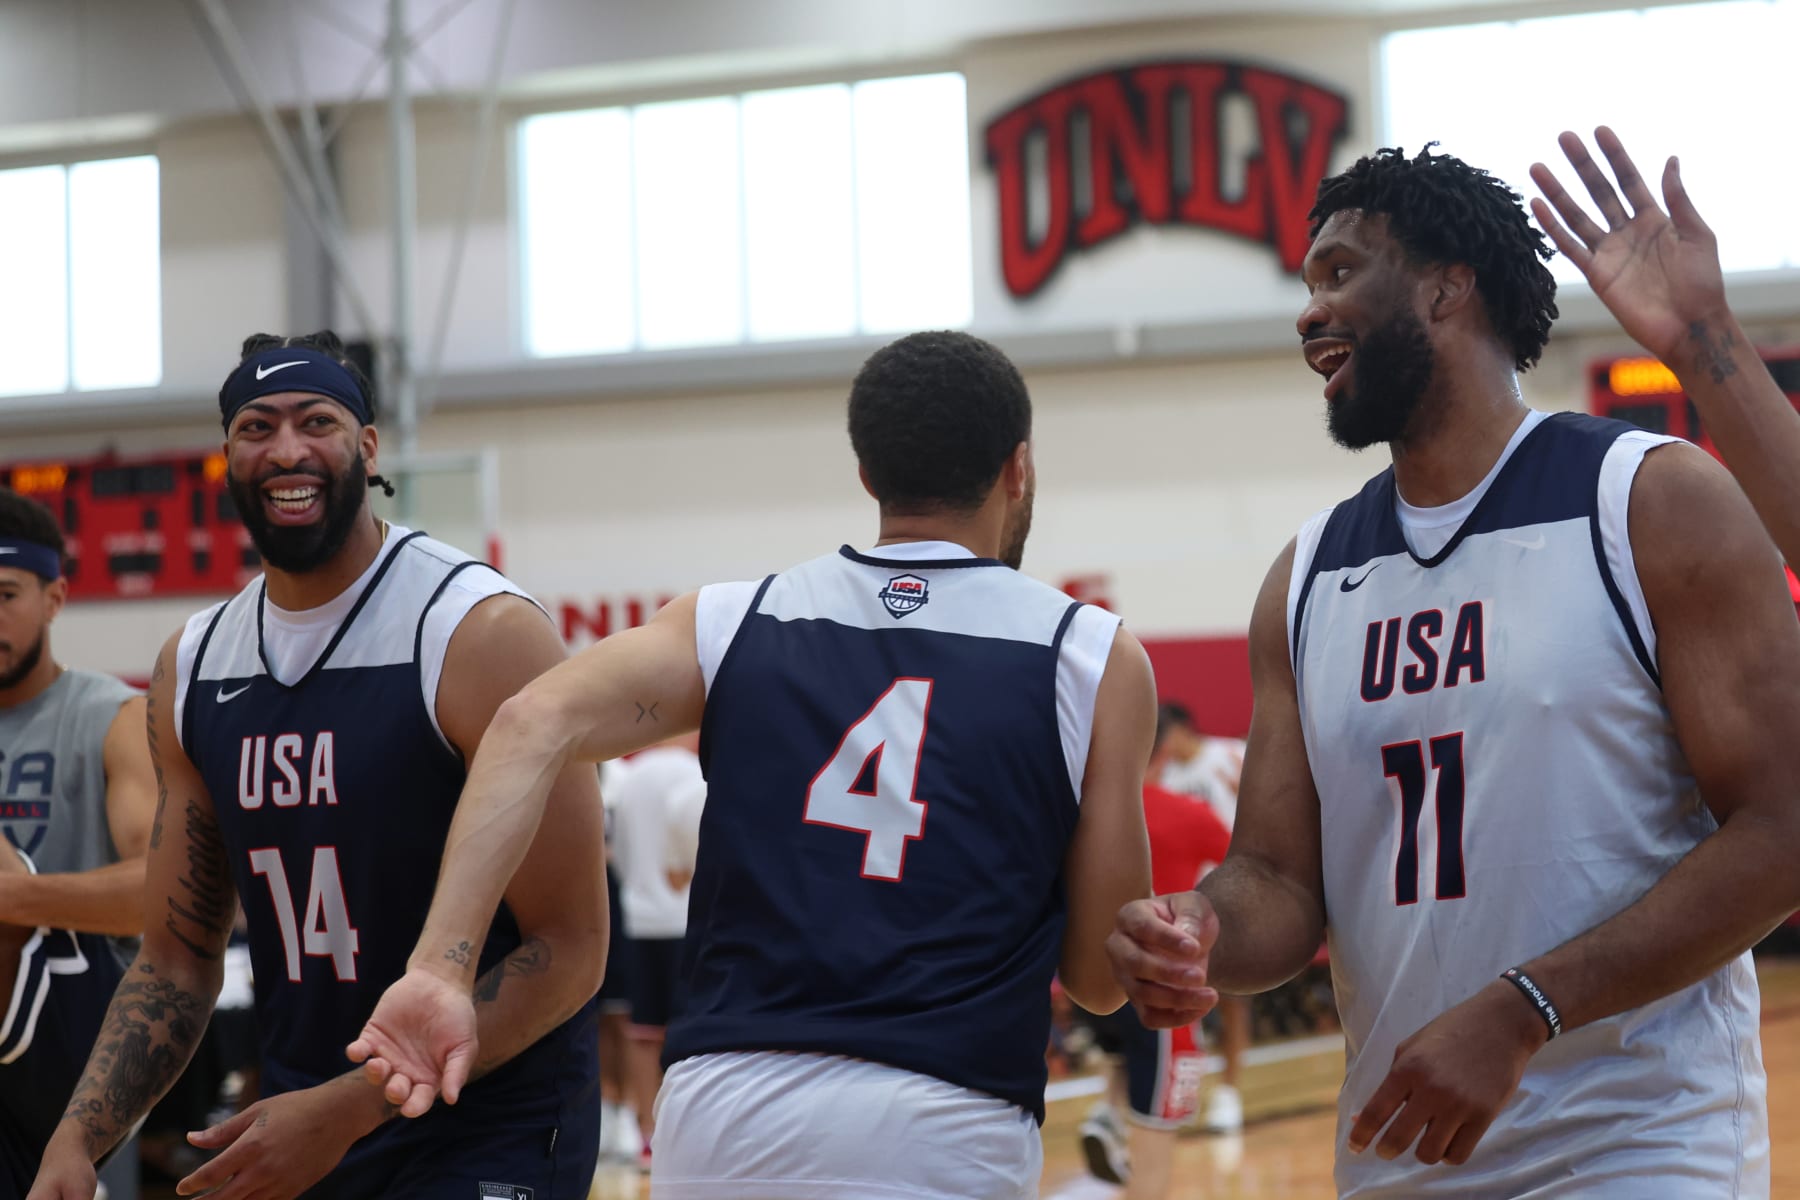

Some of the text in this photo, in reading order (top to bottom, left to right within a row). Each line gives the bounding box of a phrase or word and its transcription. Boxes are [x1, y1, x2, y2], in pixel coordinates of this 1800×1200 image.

[985, 59, 1348, 299] UNLV
[892, 582, 922, 595] USA
[1361, 600, 1485, 702] USA
[0, 751, 55, 795] A
[238, 731, 338, 810] USA
[802, 676, 934, 882] 4
[1381, 731, 1466, 906] 11
[249, 846, 359, 982] 14
[1519, 975, 1559, 1026] The Process
